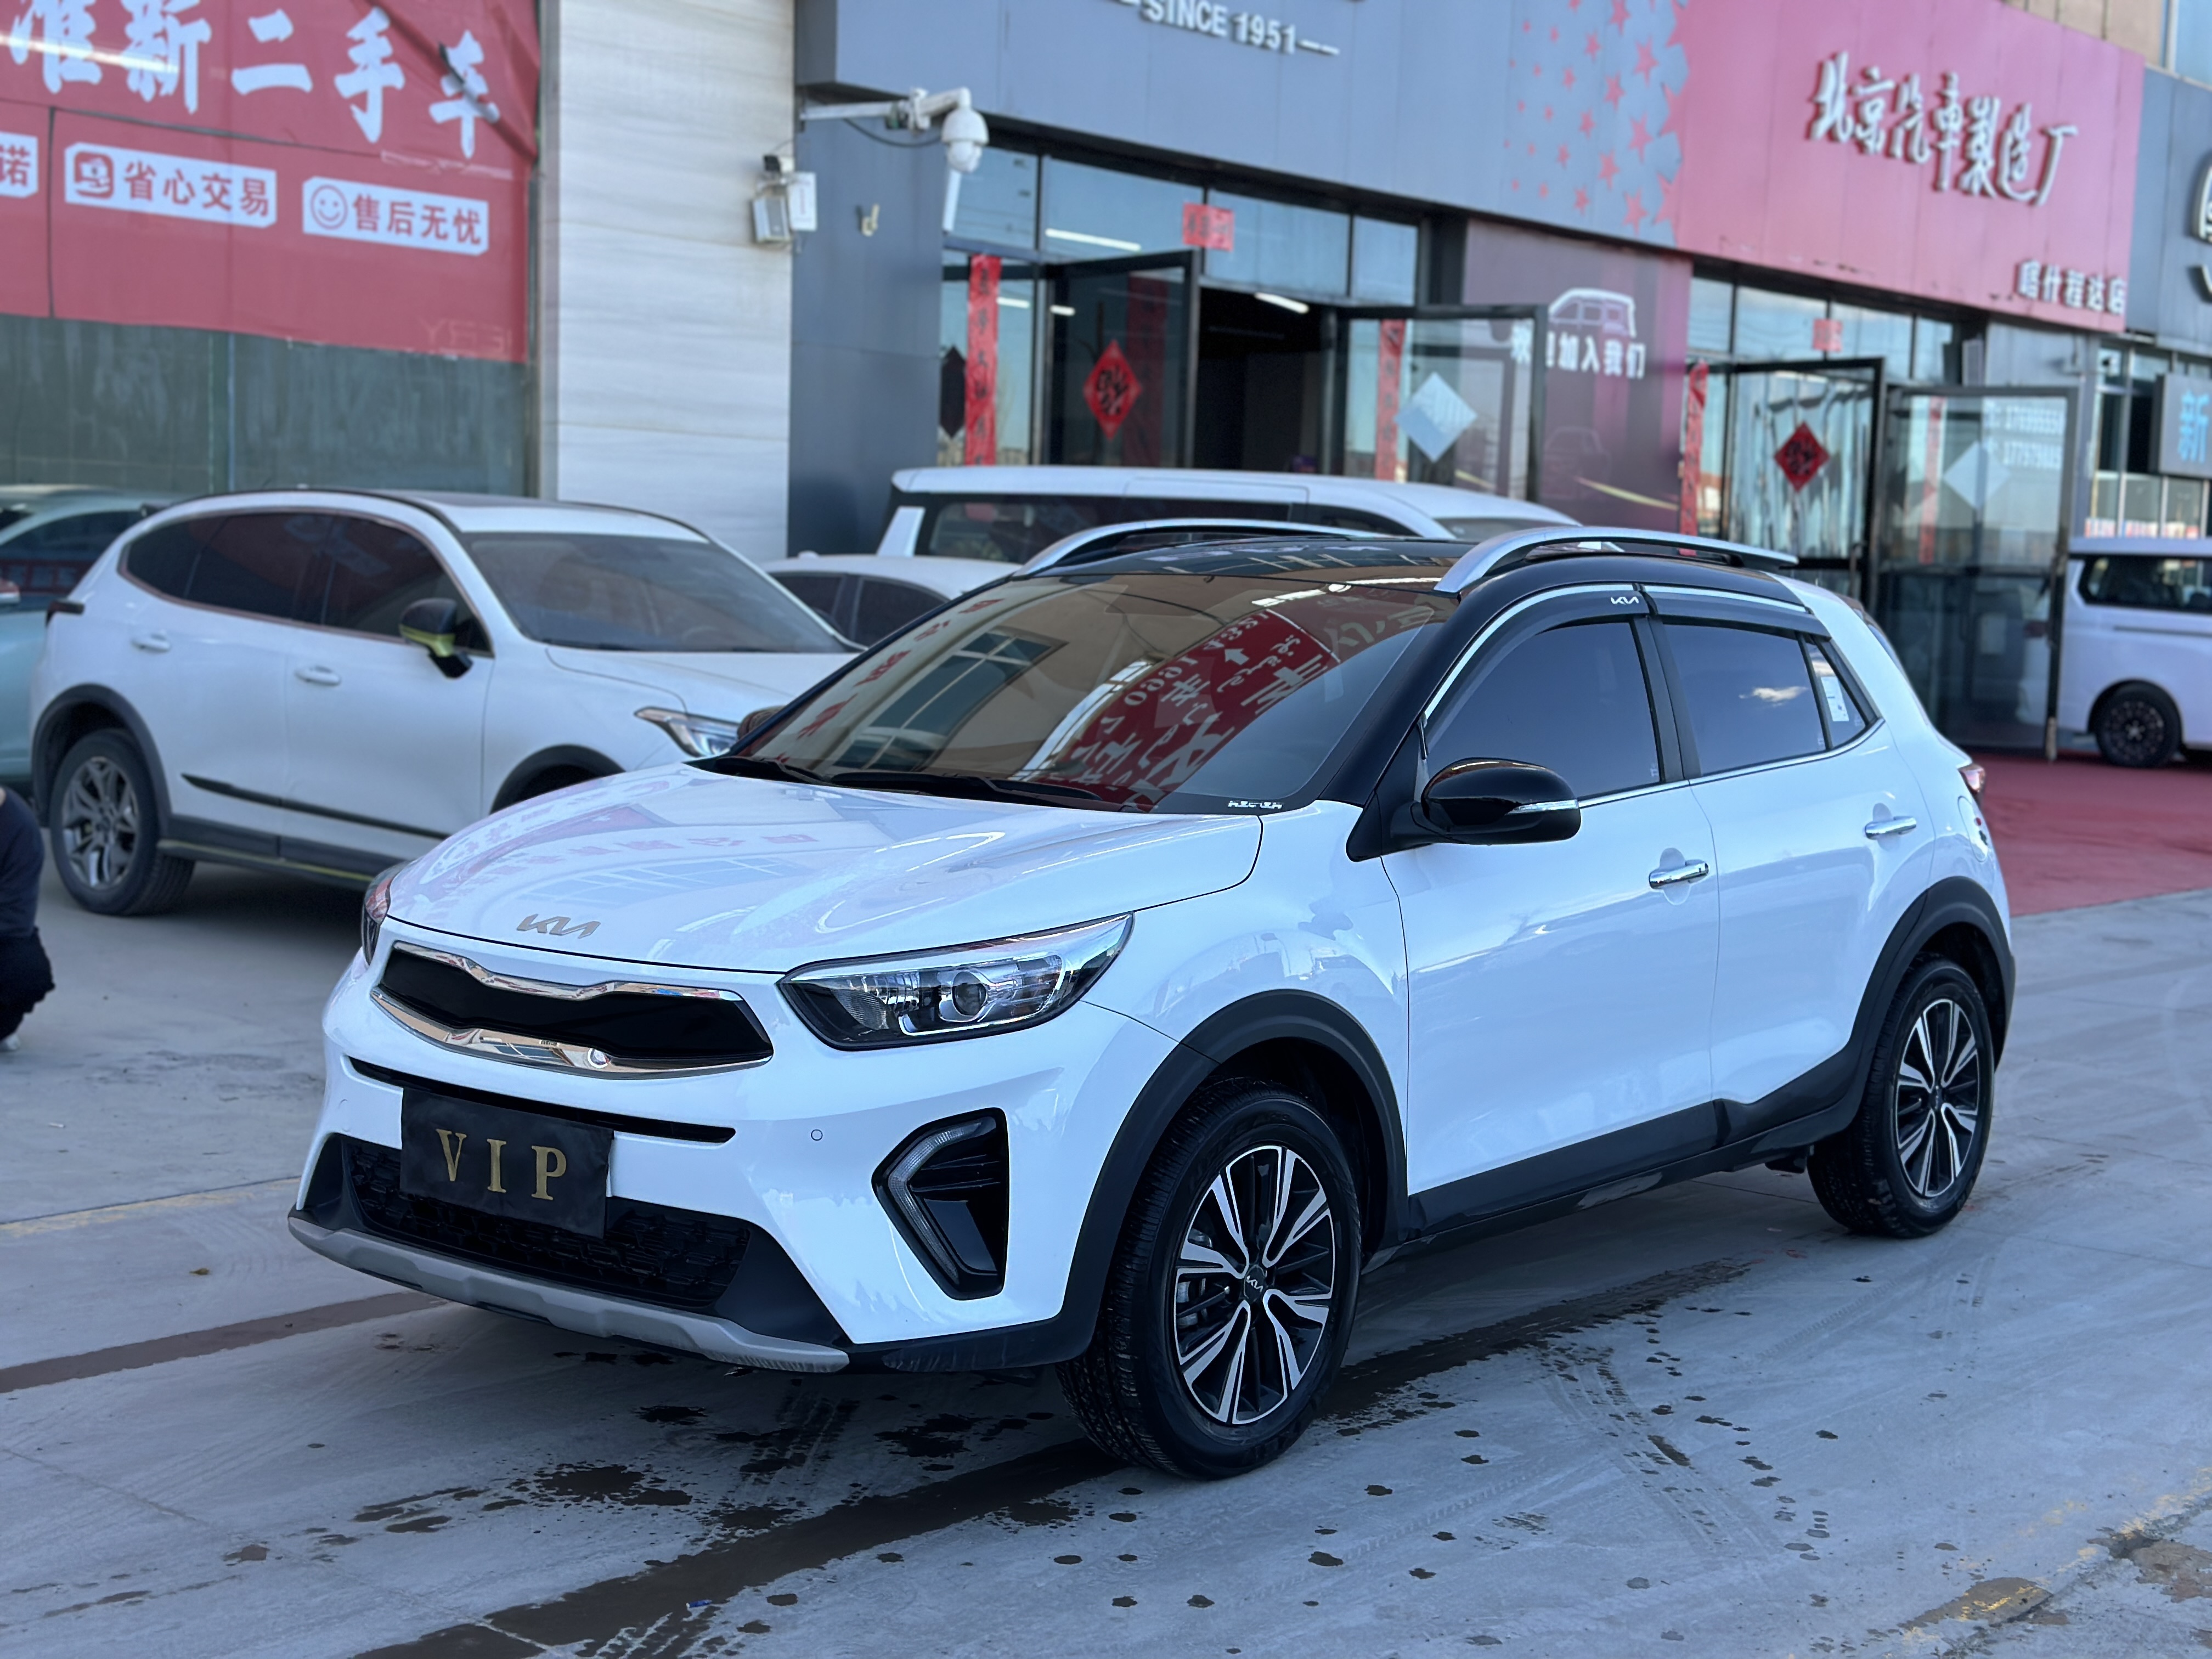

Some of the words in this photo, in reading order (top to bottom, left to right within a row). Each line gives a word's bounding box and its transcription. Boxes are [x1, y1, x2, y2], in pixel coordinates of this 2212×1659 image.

[1143, 0, 1228, 37] SINCE
[1232, 12, 1297, 54] 1951
[124, 160, 270, 218] 省心交易
[352, 193, 482, 246] 售后无忧
[2177, 388, 2210, 464] 新
[435, 1128, 568, 1201] VIP
